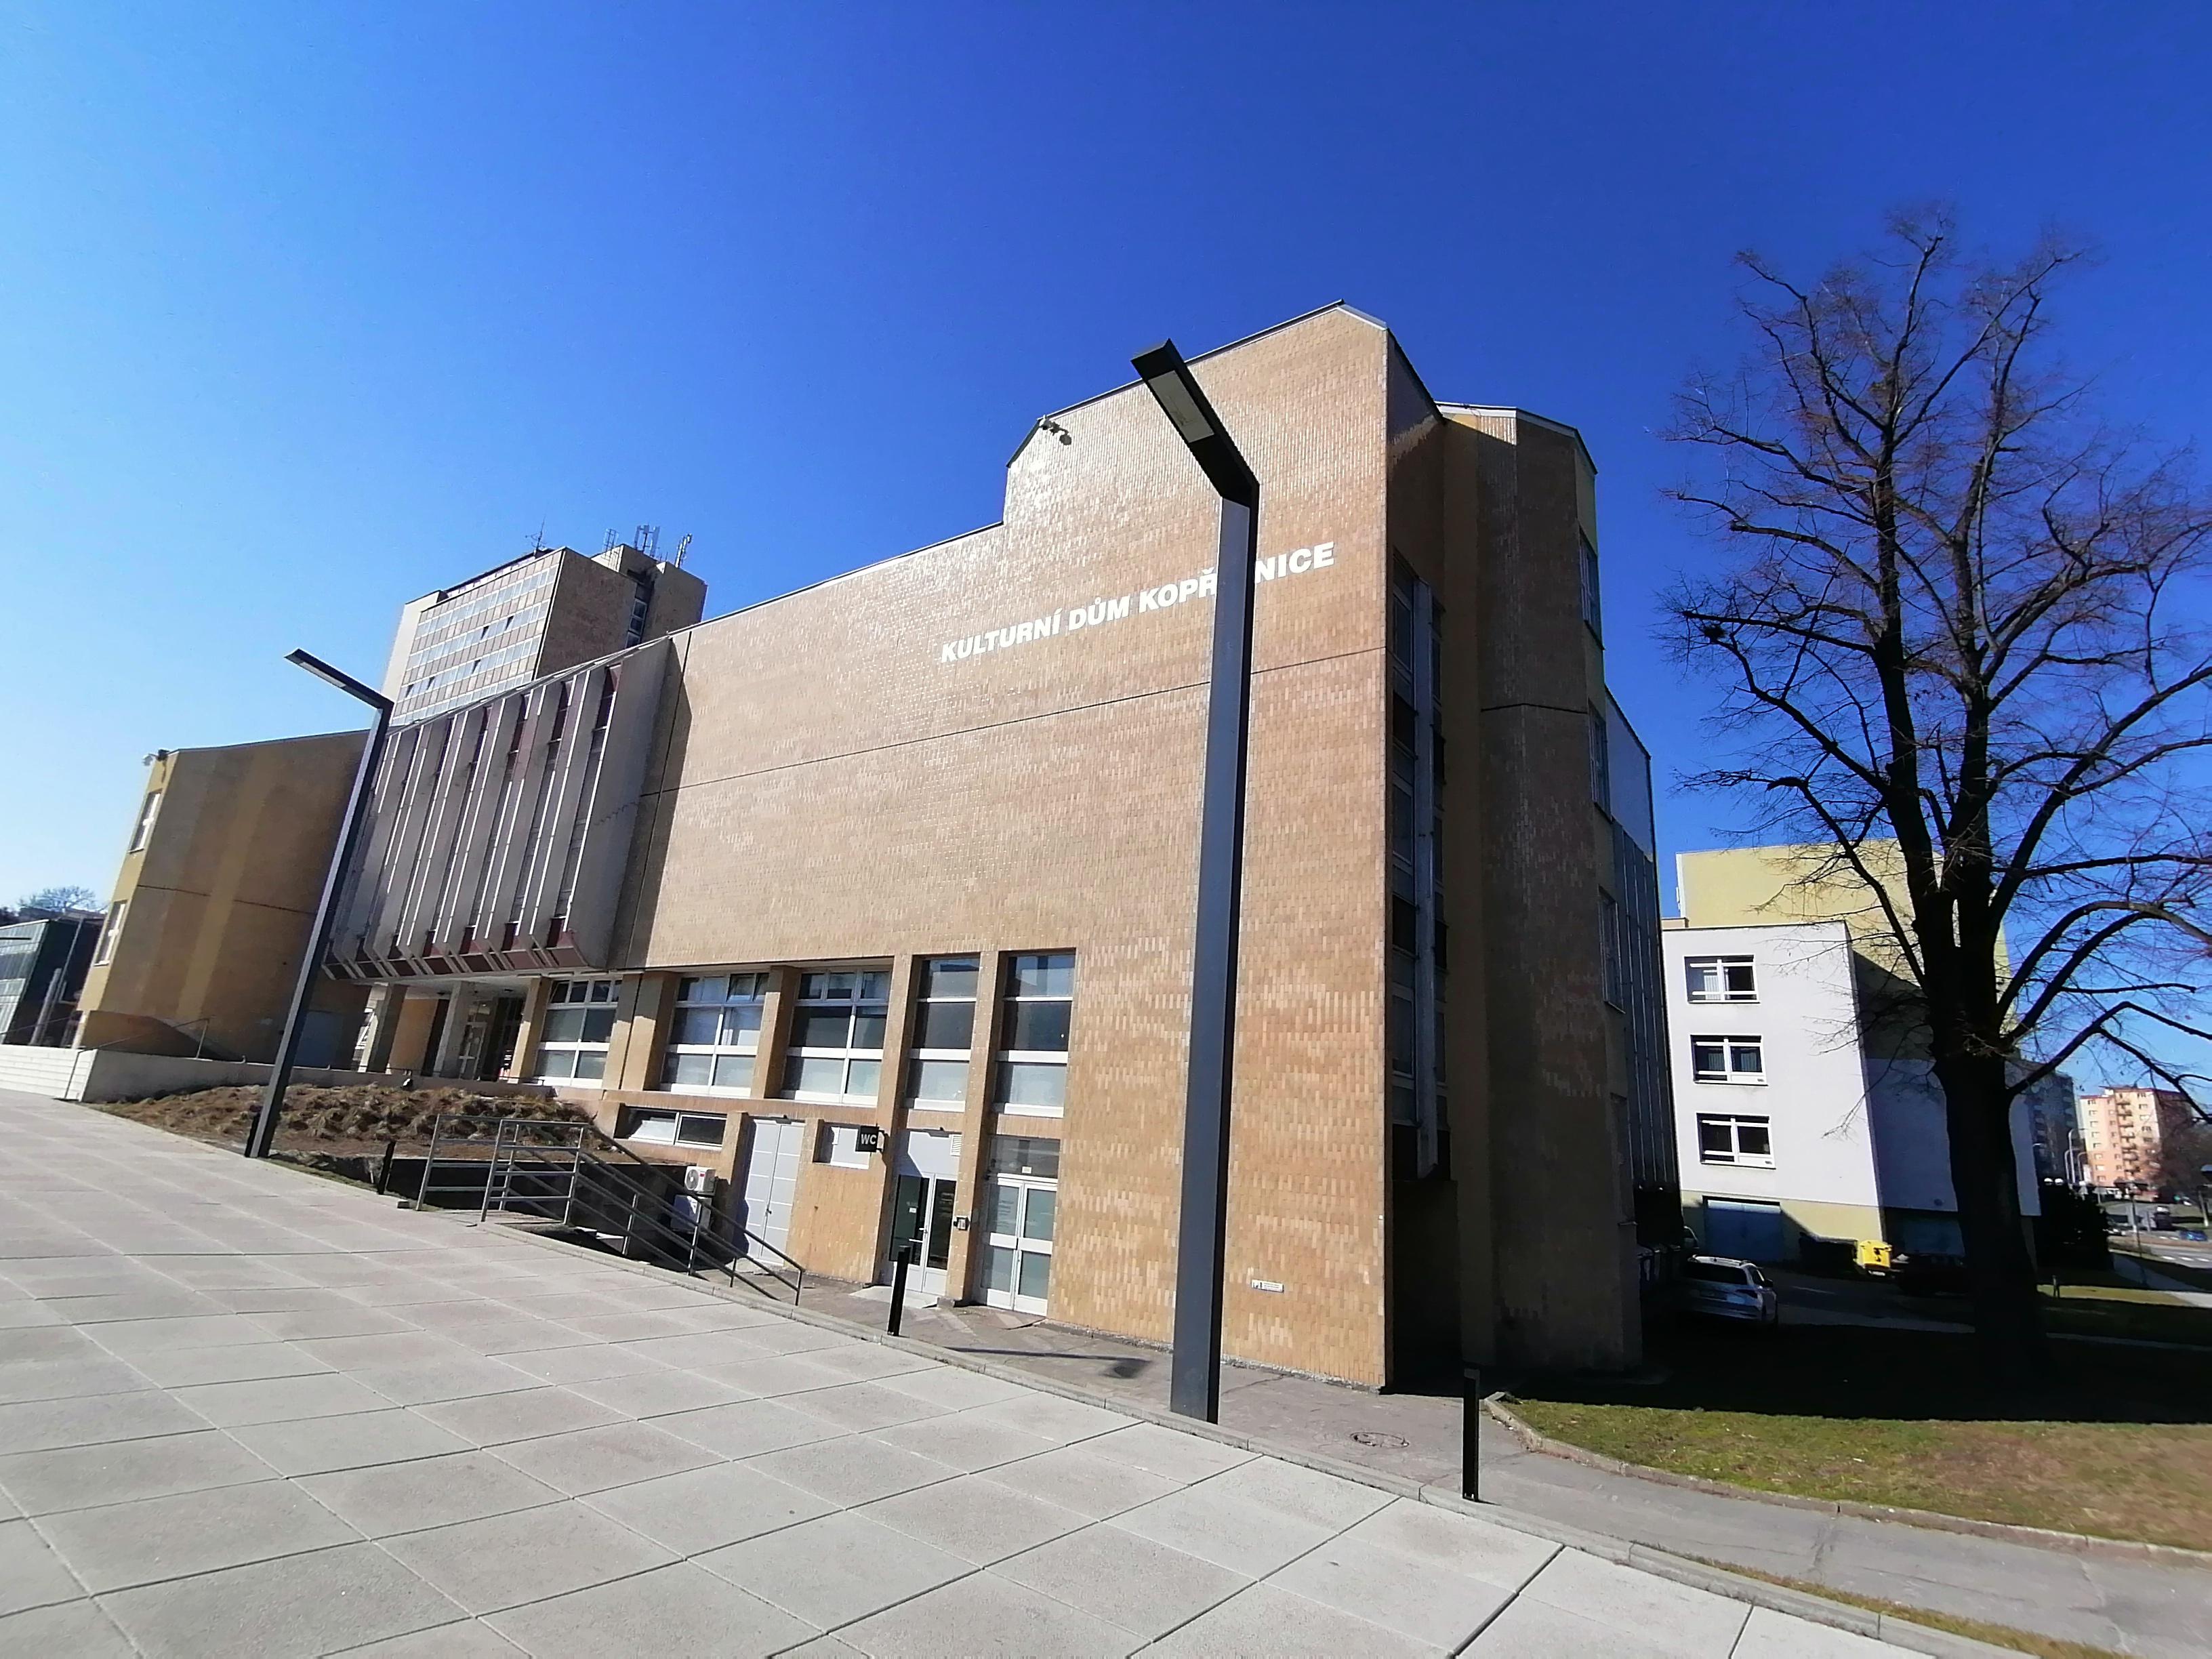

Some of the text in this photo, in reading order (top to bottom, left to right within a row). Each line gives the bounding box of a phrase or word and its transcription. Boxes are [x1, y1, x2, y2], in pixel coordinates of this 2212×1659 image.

[941, 541, 1334, 663] KULTURNÍ DŮM KOPŘNICE
[861, 1133, 877, 1145] WC
